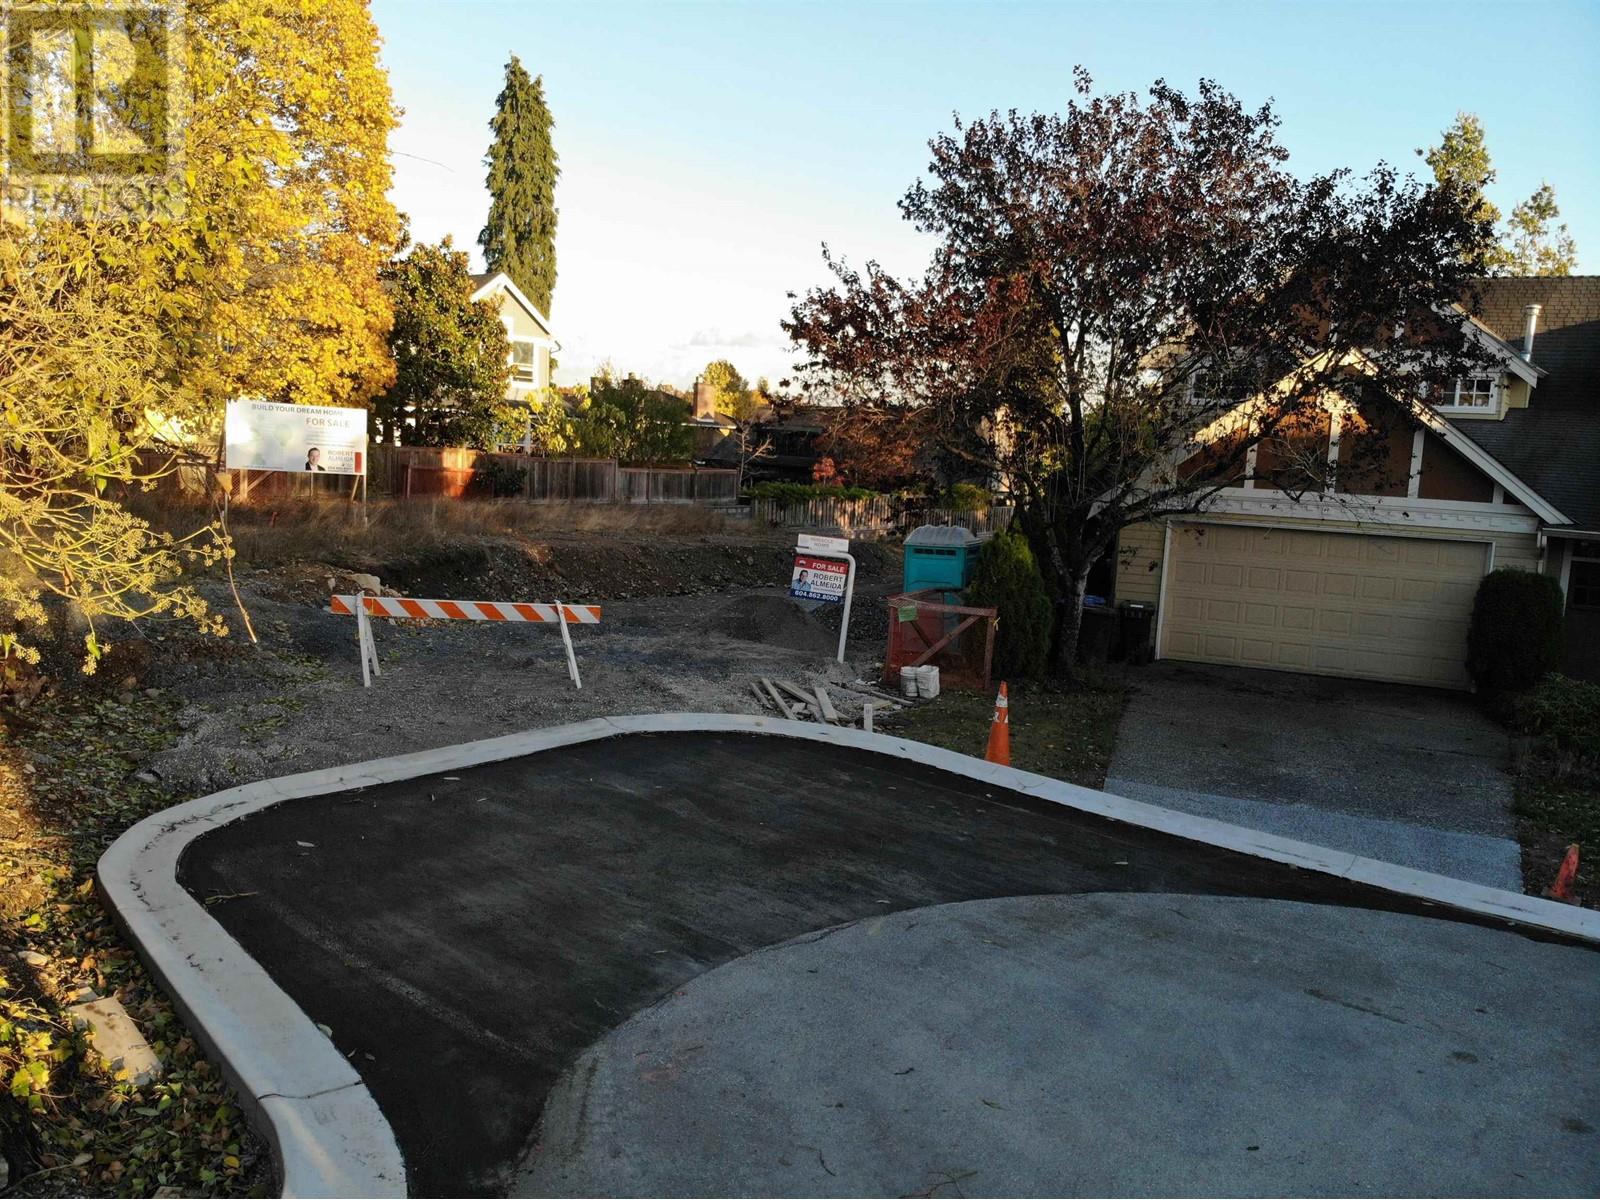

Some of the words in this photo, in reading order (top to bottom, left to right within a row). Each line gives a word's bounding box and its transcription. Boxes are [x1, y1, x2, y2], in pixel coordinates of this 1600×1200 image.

[251, 403, 274, 411] BUILD
[275, 404, 295, 412] YOUR
[296, 405, 322, 415] DREAM
[323, 408, 343, 416] HOME
[306, 417, 325, 427] FOR
[327, 418, 350, 428] SALE
[812, 562, 826, 571] FOR
[827, 564, 845, 573] SALE
[813, 572, 843, 582] ROBERT
[811, 579, 842, 590] ALMEIDA
